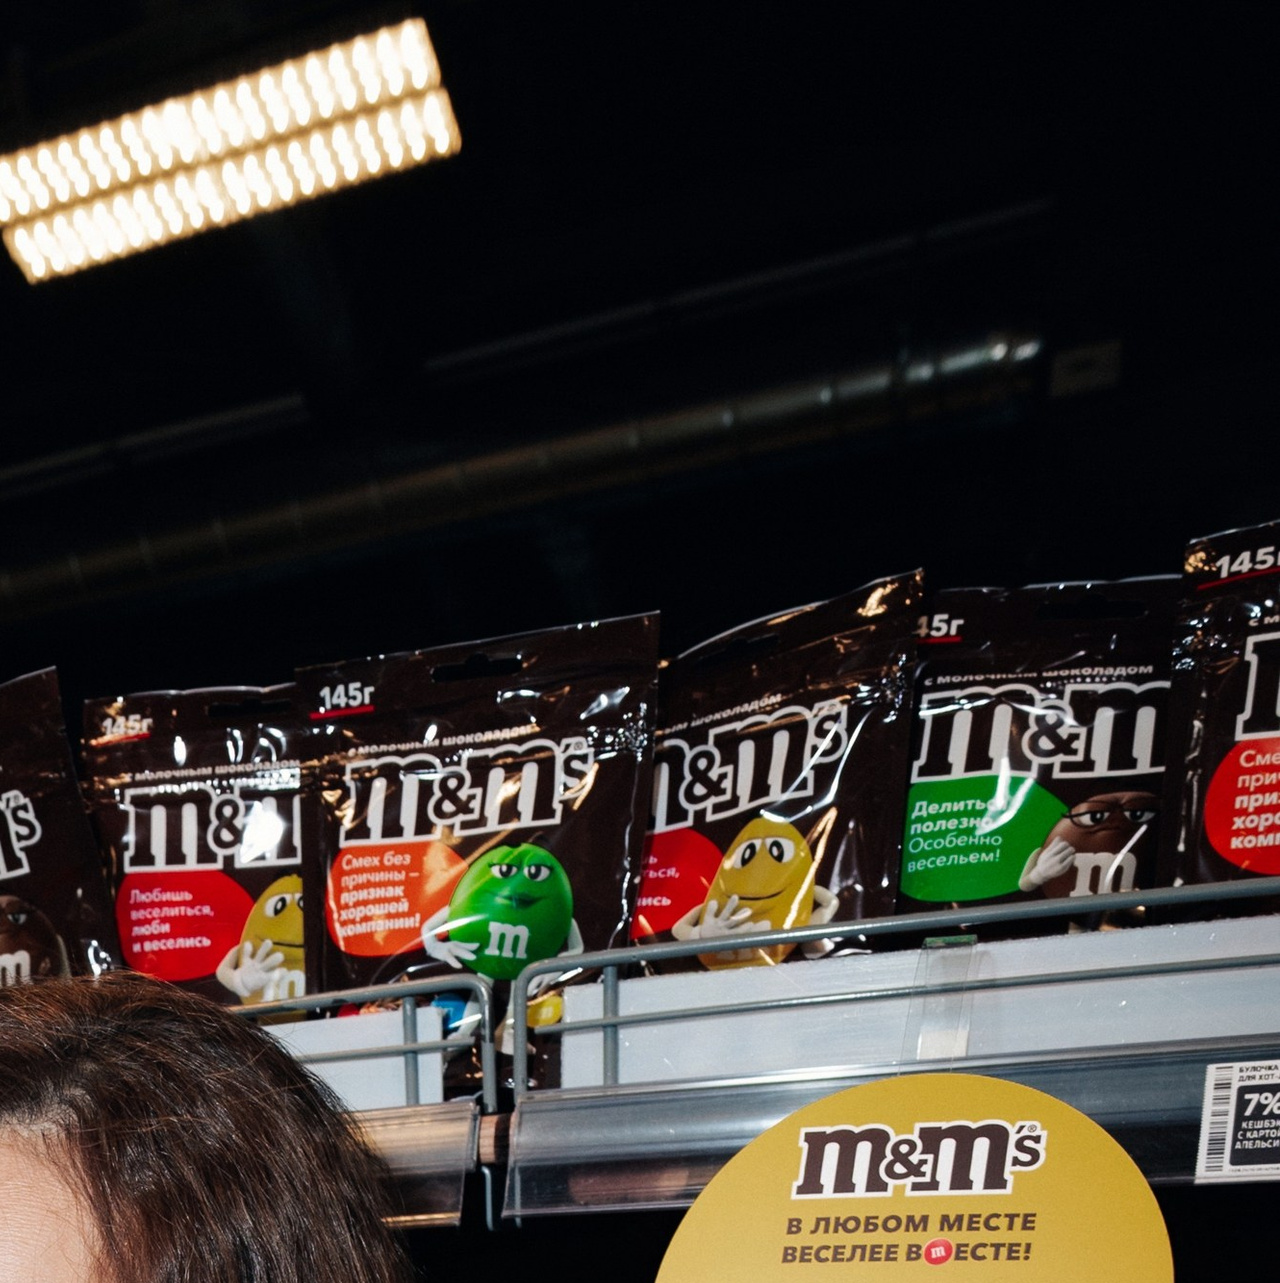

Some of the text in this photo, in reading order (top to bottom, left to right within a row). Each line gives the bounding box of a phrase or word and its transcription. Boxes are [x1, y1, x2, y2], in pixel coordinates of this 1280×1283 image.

[917, 613, 965, 638] 45г
[1042, 665, 1155, 679] шоколадом
[320, 681, 376, 711] 145г
[910, 681, 1172, 784] m&m
[1240, 749, 1280, 769] Сме
[1231, 811, 1280, 832] хоро
[908, 833, 1003, 853] Особенно
[341, 850, 412, 871] Смех без
[907, 849, 1001, 873] весельем!
[341, 869, 407, 890] причины
[340, 886, 405, 906] признак
[340, 898, 410, 921] хорошей
[339, 913, 422, 938] компании!
[1258, 1072, 1280, 1081] ХОТ-
[1244, 1091, 1280, 1116] 7%
[1234, 1139, 1280, 1150] АПЕЛЬСИ
[786, 1212, 1037, 1236] В ЛЮБОМ МЕСТЕ
[781, 1245, 899, 1265] ВЕСЕЛЕЕ
